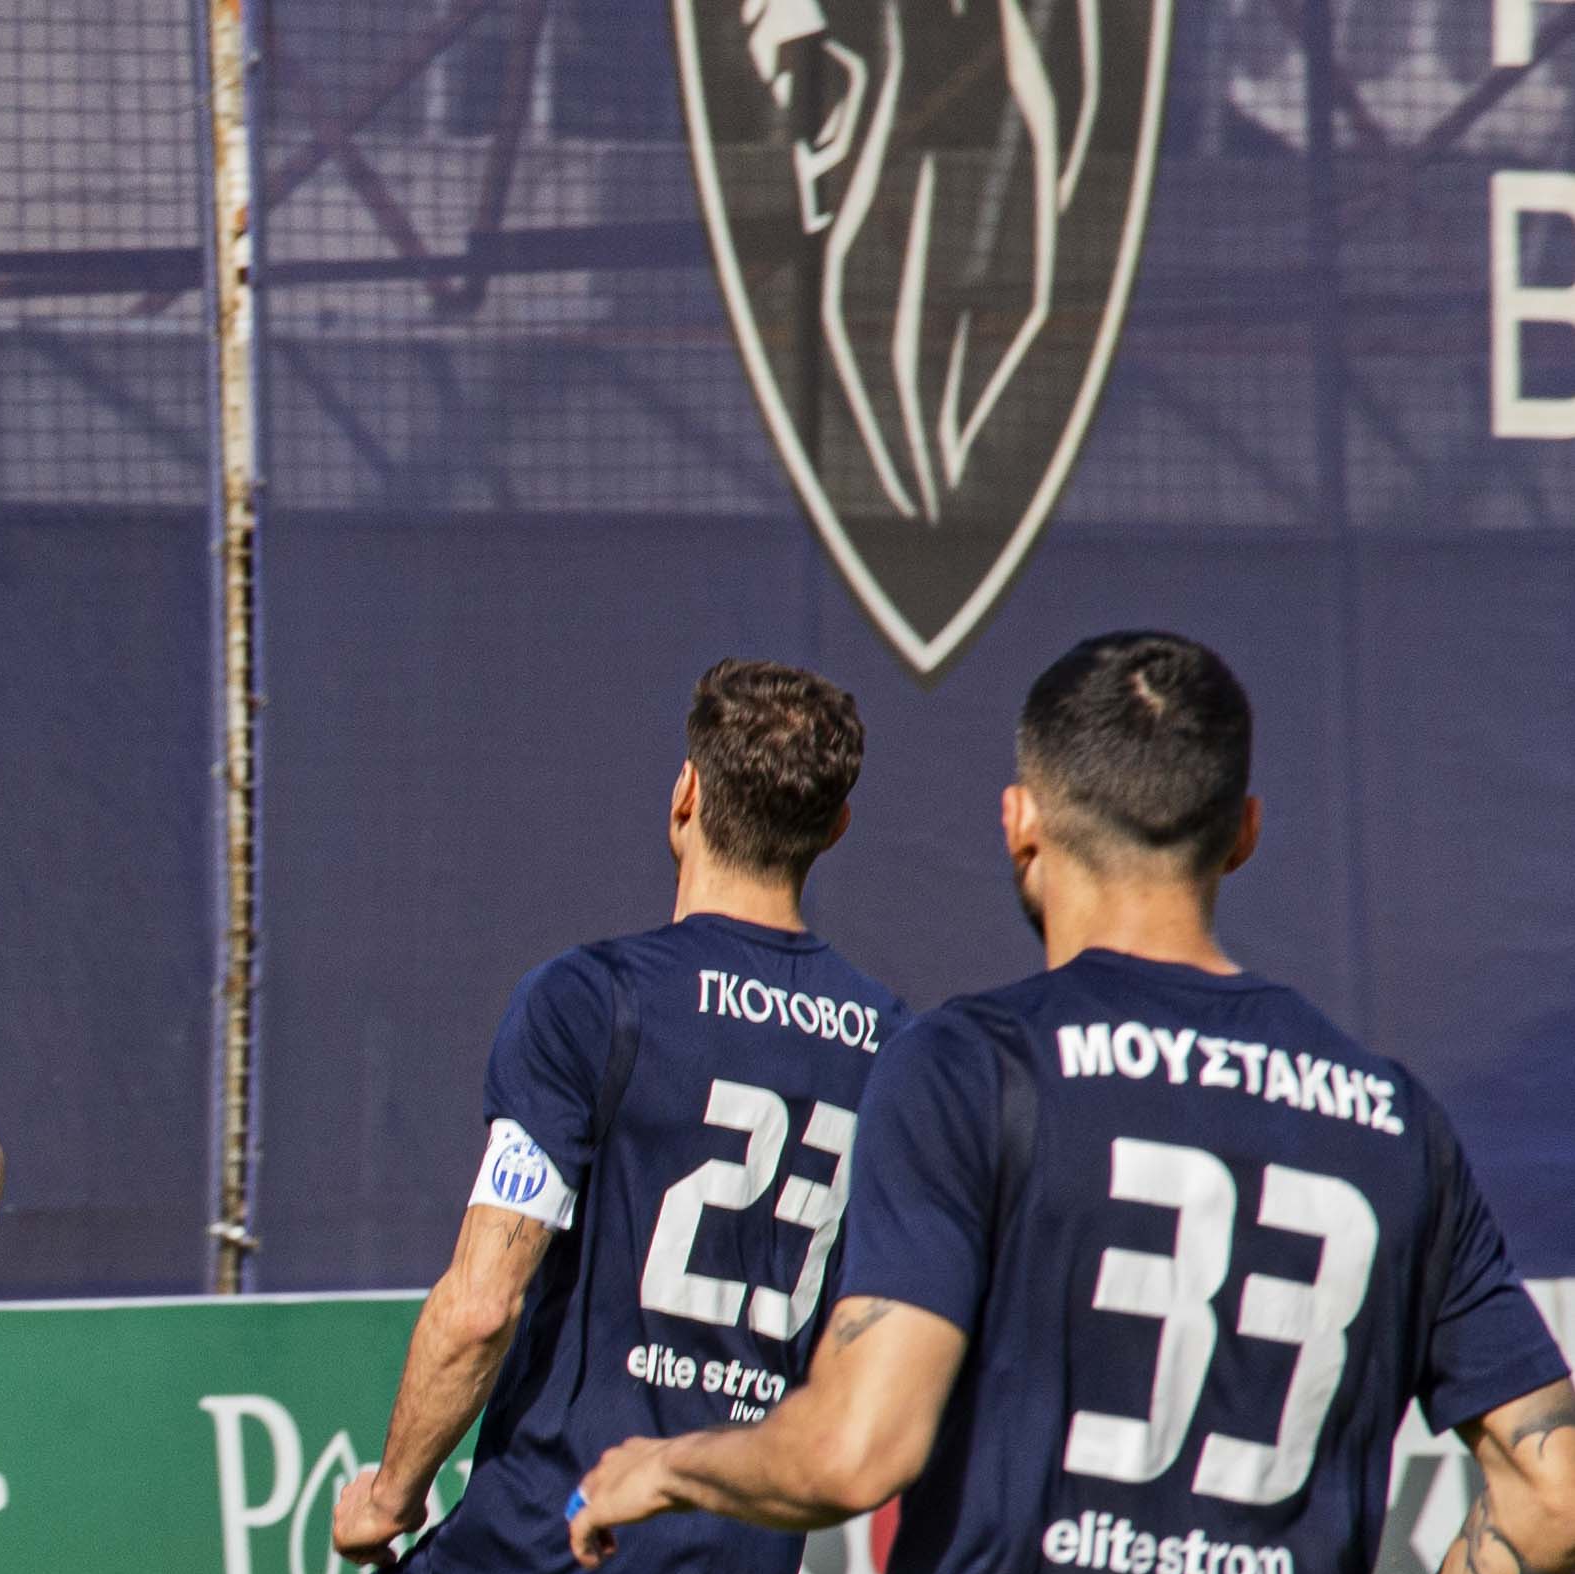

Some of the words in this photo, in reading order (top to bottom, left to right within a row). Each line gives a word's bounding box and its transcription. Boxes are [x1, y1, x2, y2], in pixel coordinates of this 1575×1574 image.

[698, 969, 880, 1054] ΓΚΟΤΟΒΟΣ
[1057, 1022, 1404, 1135] ΜΟΥΣΤΑΚΗΣ
[641, 1076, 858, 1342] 23
[627, 1343, 697, 1389] elite
[1063, 1137, 1380, 1507] 33
